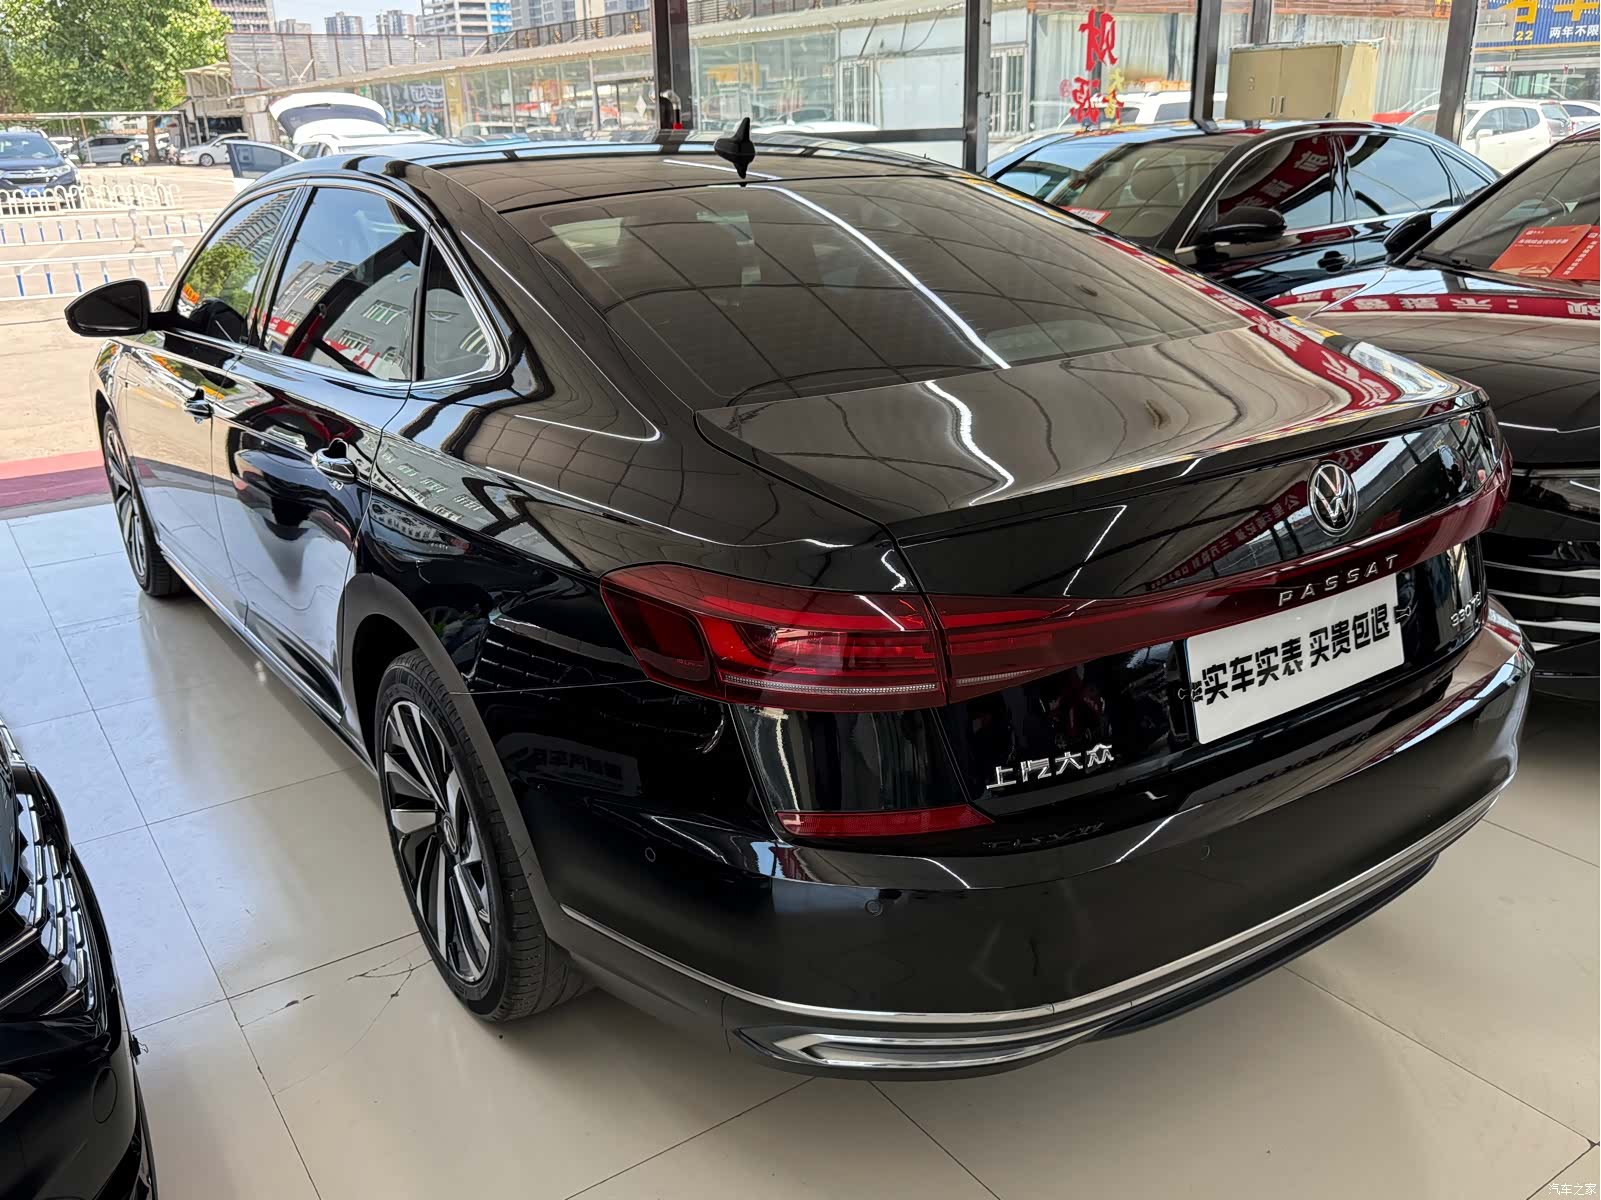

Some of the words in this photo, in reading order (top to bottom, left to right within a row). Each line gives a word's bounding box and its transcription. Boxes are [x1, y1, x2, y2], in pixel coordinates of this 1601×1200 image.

[1549, 24, 1599, 40] 两年不限
[1278, 554, 1398, 607] PASSAT
[1201, 636, 1304, 706] 实车实表
[1309, 603, 1391, 669] 买贵包退
[986, 743, 1114, 789] 上汽大众
